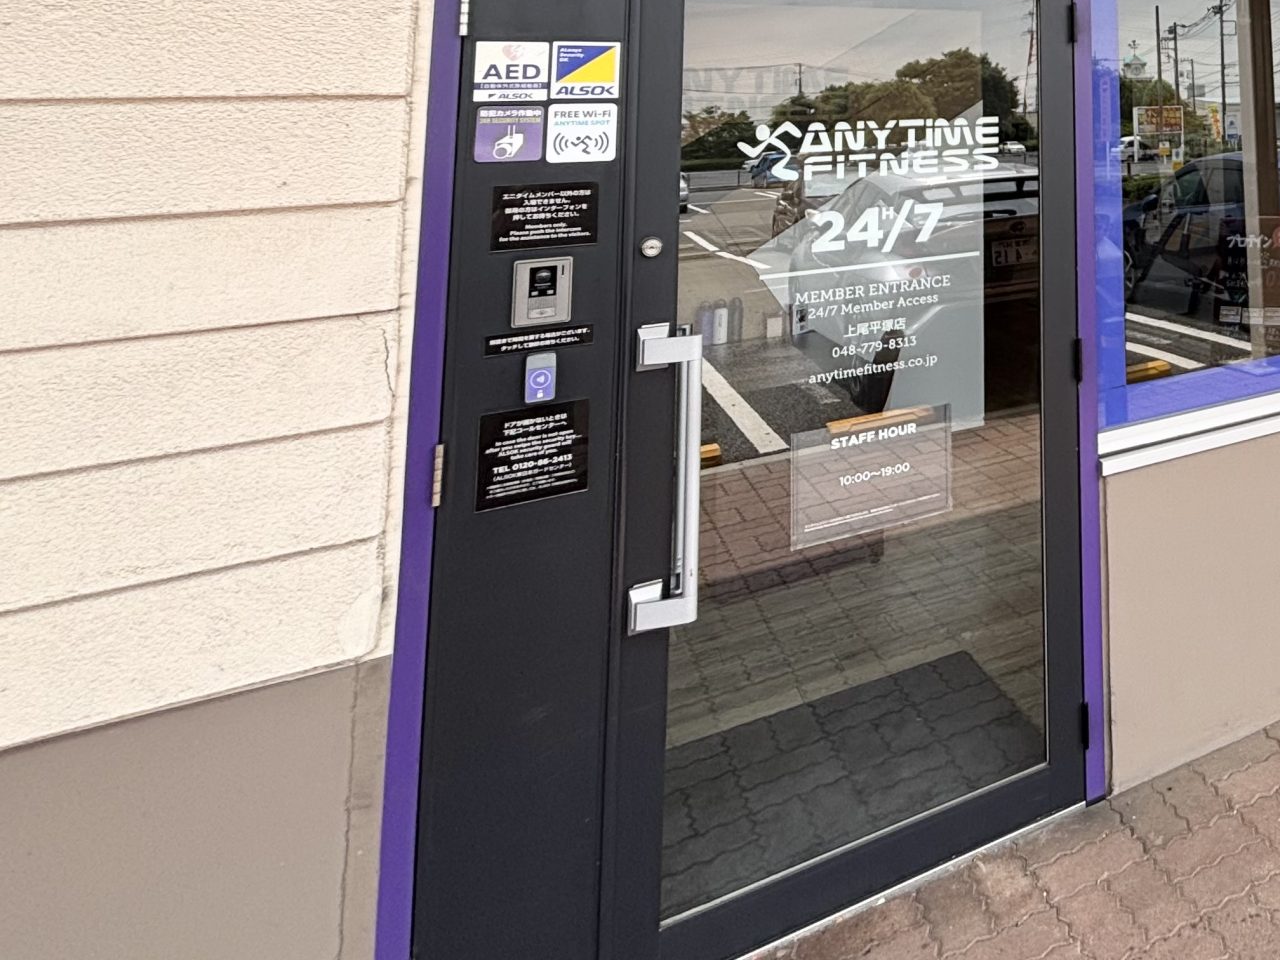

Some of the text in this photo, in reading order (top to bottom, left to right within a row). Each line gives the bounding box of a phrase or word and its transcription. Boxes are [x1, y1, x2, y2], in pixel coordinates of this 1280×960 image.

[482, 64, 541, 80] AED
[556, 86, 614, 96] ALSOK
[554, 109, 611, 118] FREE Wi-Fi
[799, 116, 1000, 153] ANYTIME
[804, 146, 1000, 181] FITNESS
[795, 274, 951, 306] MEMBER ENTRANCE
[808, 293, 939, 320] 24/7 Member Access
[843, 317, 907, 338] 上尾平塚店
[832, 335, 917, 359] 048-779-8313
[808, 353, 938, 384] anytimefitness.co.jp
[830, 422, 917, 450] STAFF HOUR
[492, 465, 510, 474] TEL
